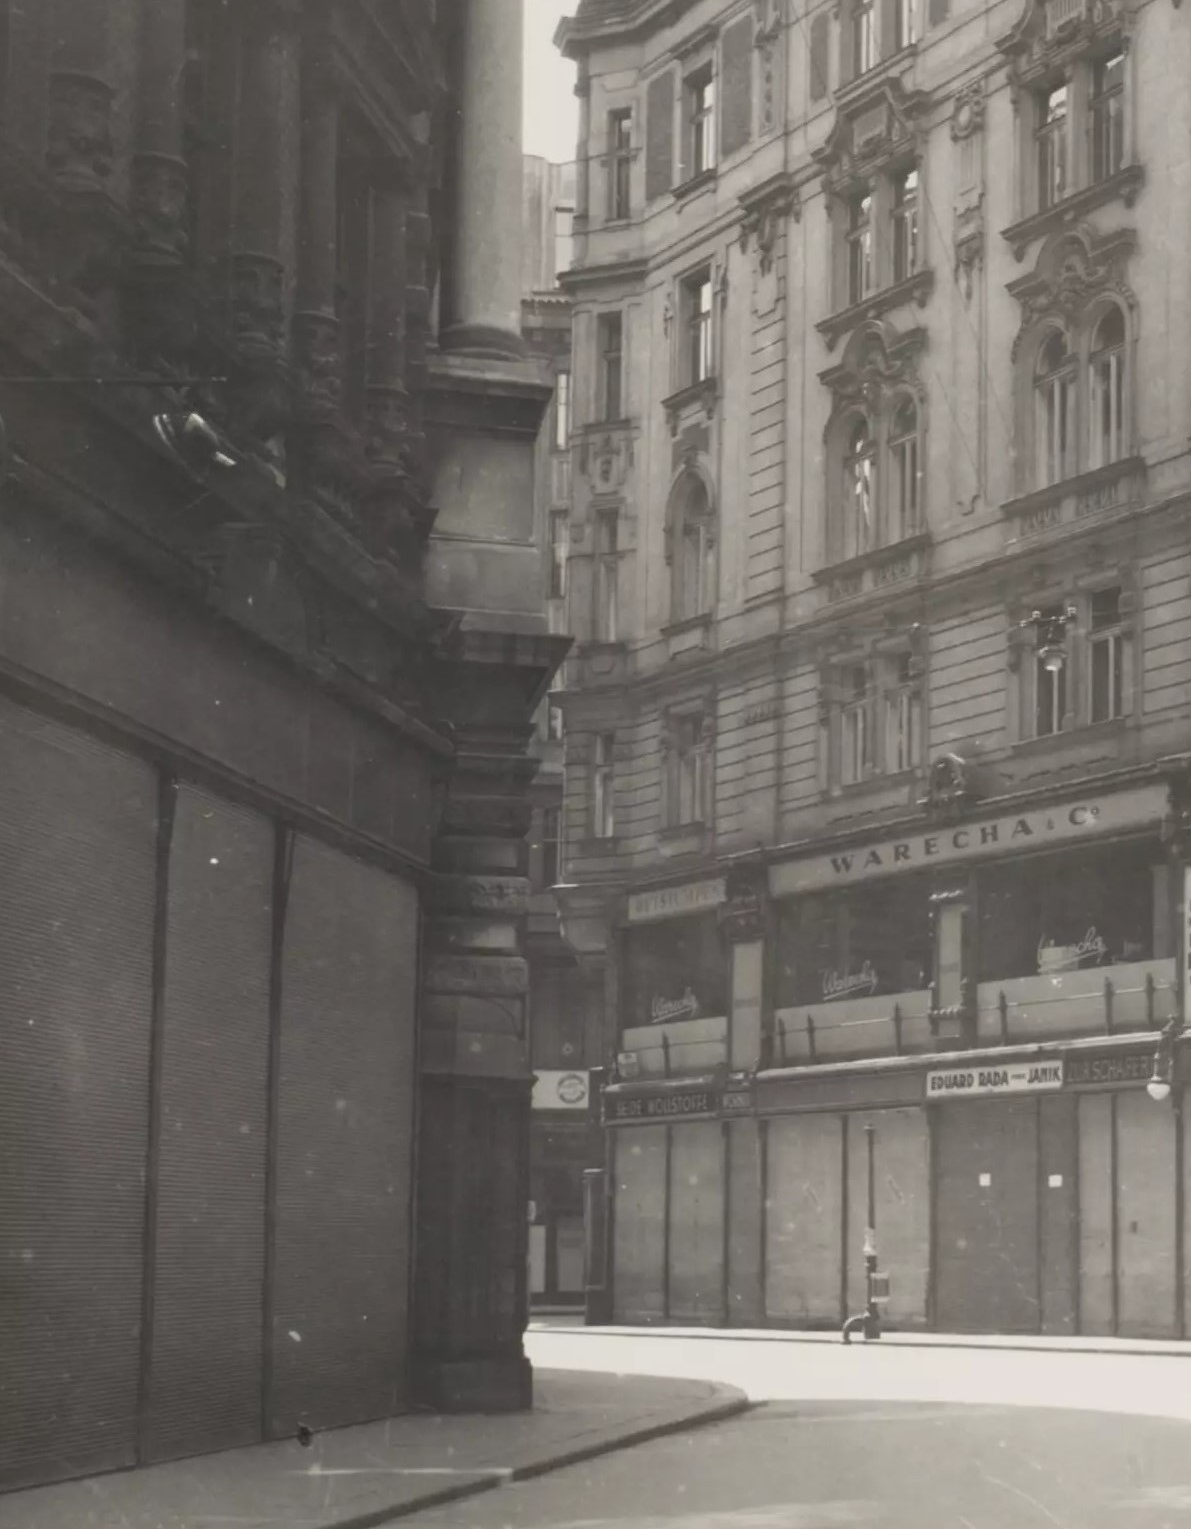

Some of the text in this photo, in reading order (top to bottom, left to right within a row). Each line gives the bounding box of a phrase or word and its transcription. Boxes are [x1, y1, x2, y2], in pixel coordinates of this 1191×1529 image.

[830, 817, 1034, 874] WARECHA
[930, 1073, 975, 1091] EDUARD
[978, 1069, 1009, 1087] RADA
